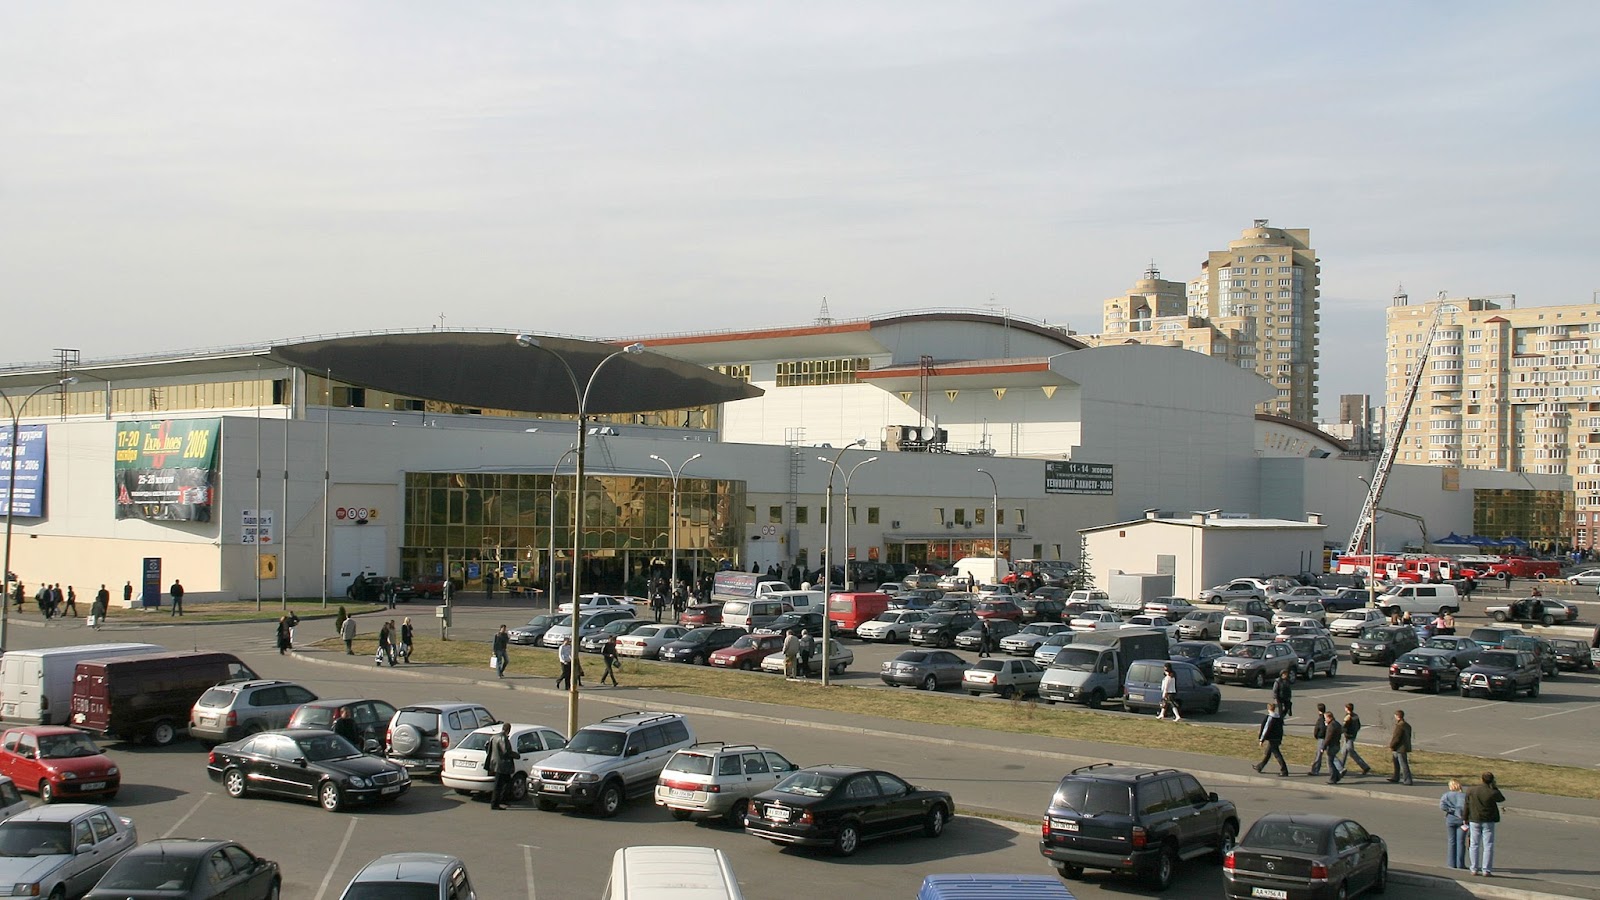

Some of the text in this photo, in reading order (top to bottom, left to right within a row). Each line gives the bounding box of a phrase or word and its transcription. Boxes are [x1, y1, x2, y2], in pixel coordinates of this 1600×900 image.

[118, 430, 140, 447] 17-20
[184, 430, 209, 458] 2006
[370, 509, 376, 518] 2
[267, 516, 272, 524] 1
[242, 535, 255, 544] 2,3
